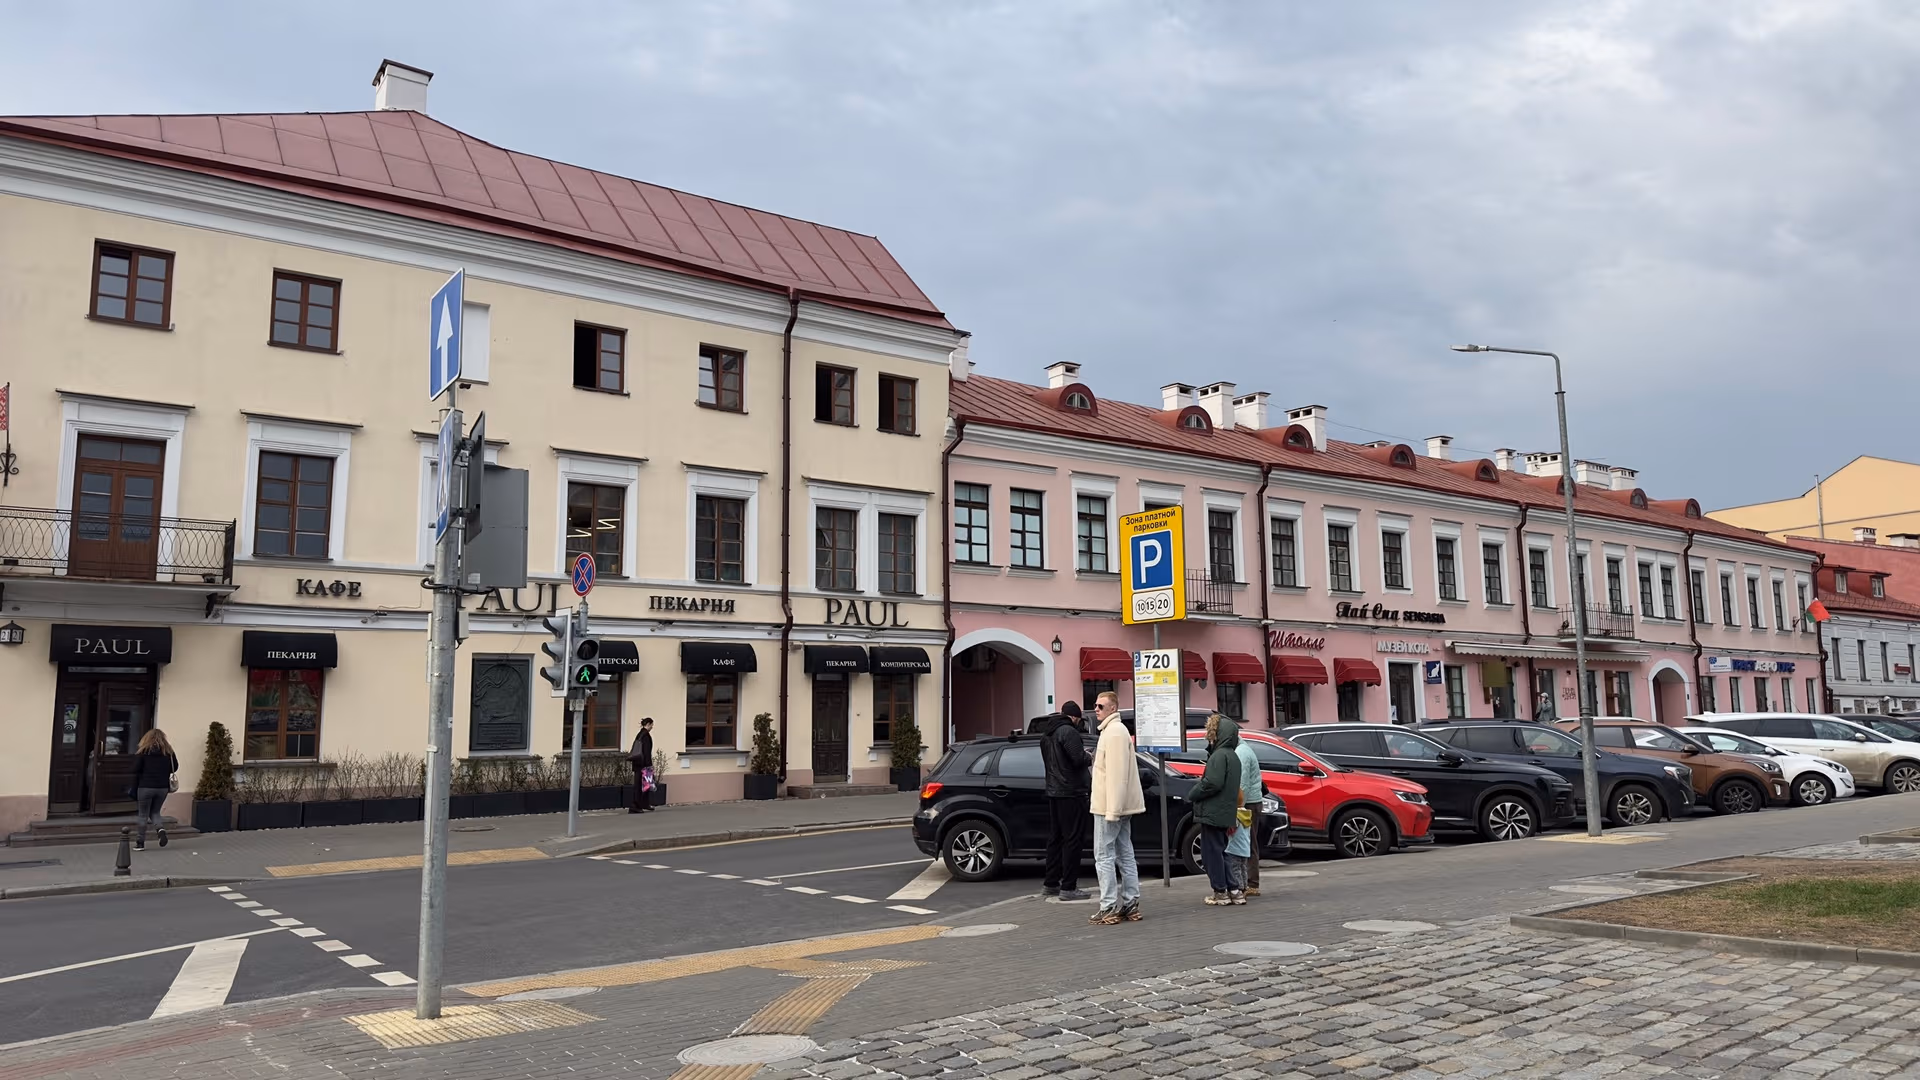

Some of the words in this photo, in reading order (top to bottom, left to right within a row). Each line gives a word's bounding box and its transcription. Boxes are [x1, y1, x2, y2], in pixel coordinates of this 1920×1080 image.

[1125, 516, 1143, 526] Зона
[1144, 508, 1176, 522] платной
[1133, 520, 1168, 533] парковки
[1140, 539, 1163, 584] P
[296, 579, 362, 598] КАФЕ
[649, 595, 736, 613] ПЕКАРНЯ
[824, 598, 909, 627] PAUL
[1137, 603, 1145, 611] 10
[1146, 601, 1155, 610] 15
[1157, 599, 1169, 610] 20
[74, 638, 151, 655] PAUL
[1377, 640, 1409, 653] МУЗЕЙ
[1409, 642, 1430, 655] КОТА
[267, 651, 317, 660] ПЕКАРНЯ
[1144, 654, 1170, 669] 720
